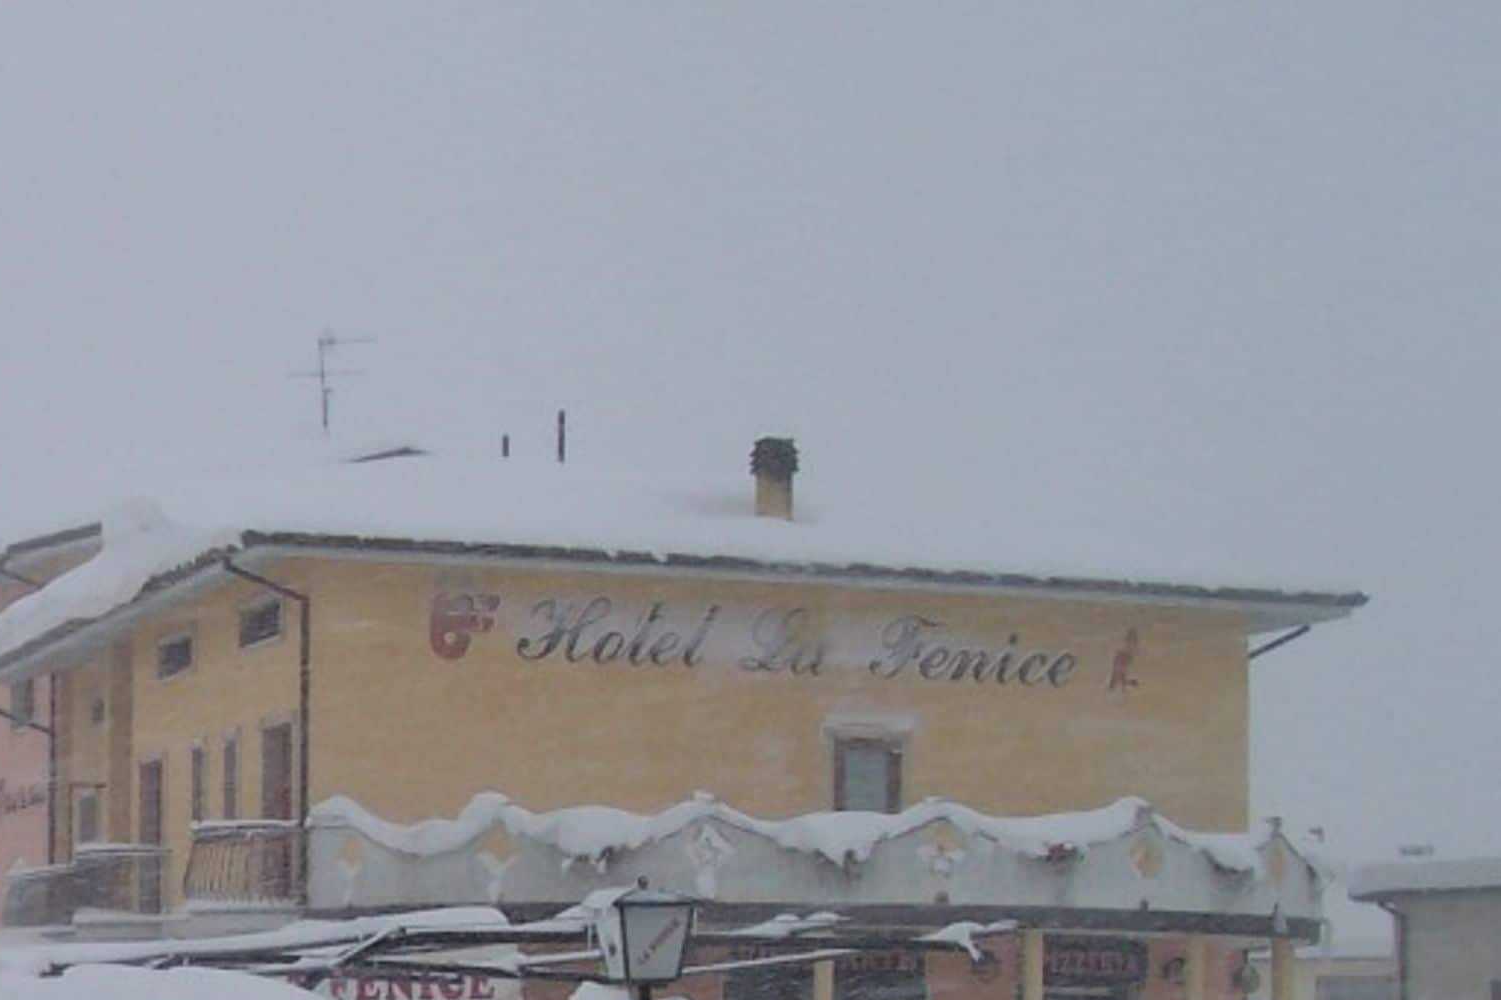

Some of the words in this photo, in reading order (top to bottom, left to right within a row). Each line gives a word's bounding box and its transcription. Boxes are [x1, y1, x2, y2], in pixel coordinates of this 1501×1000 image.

[516, 596, 721, 667] Hotel
[738, 607, 827, 677] La
[868, 615, 1077, 687] Fenice
